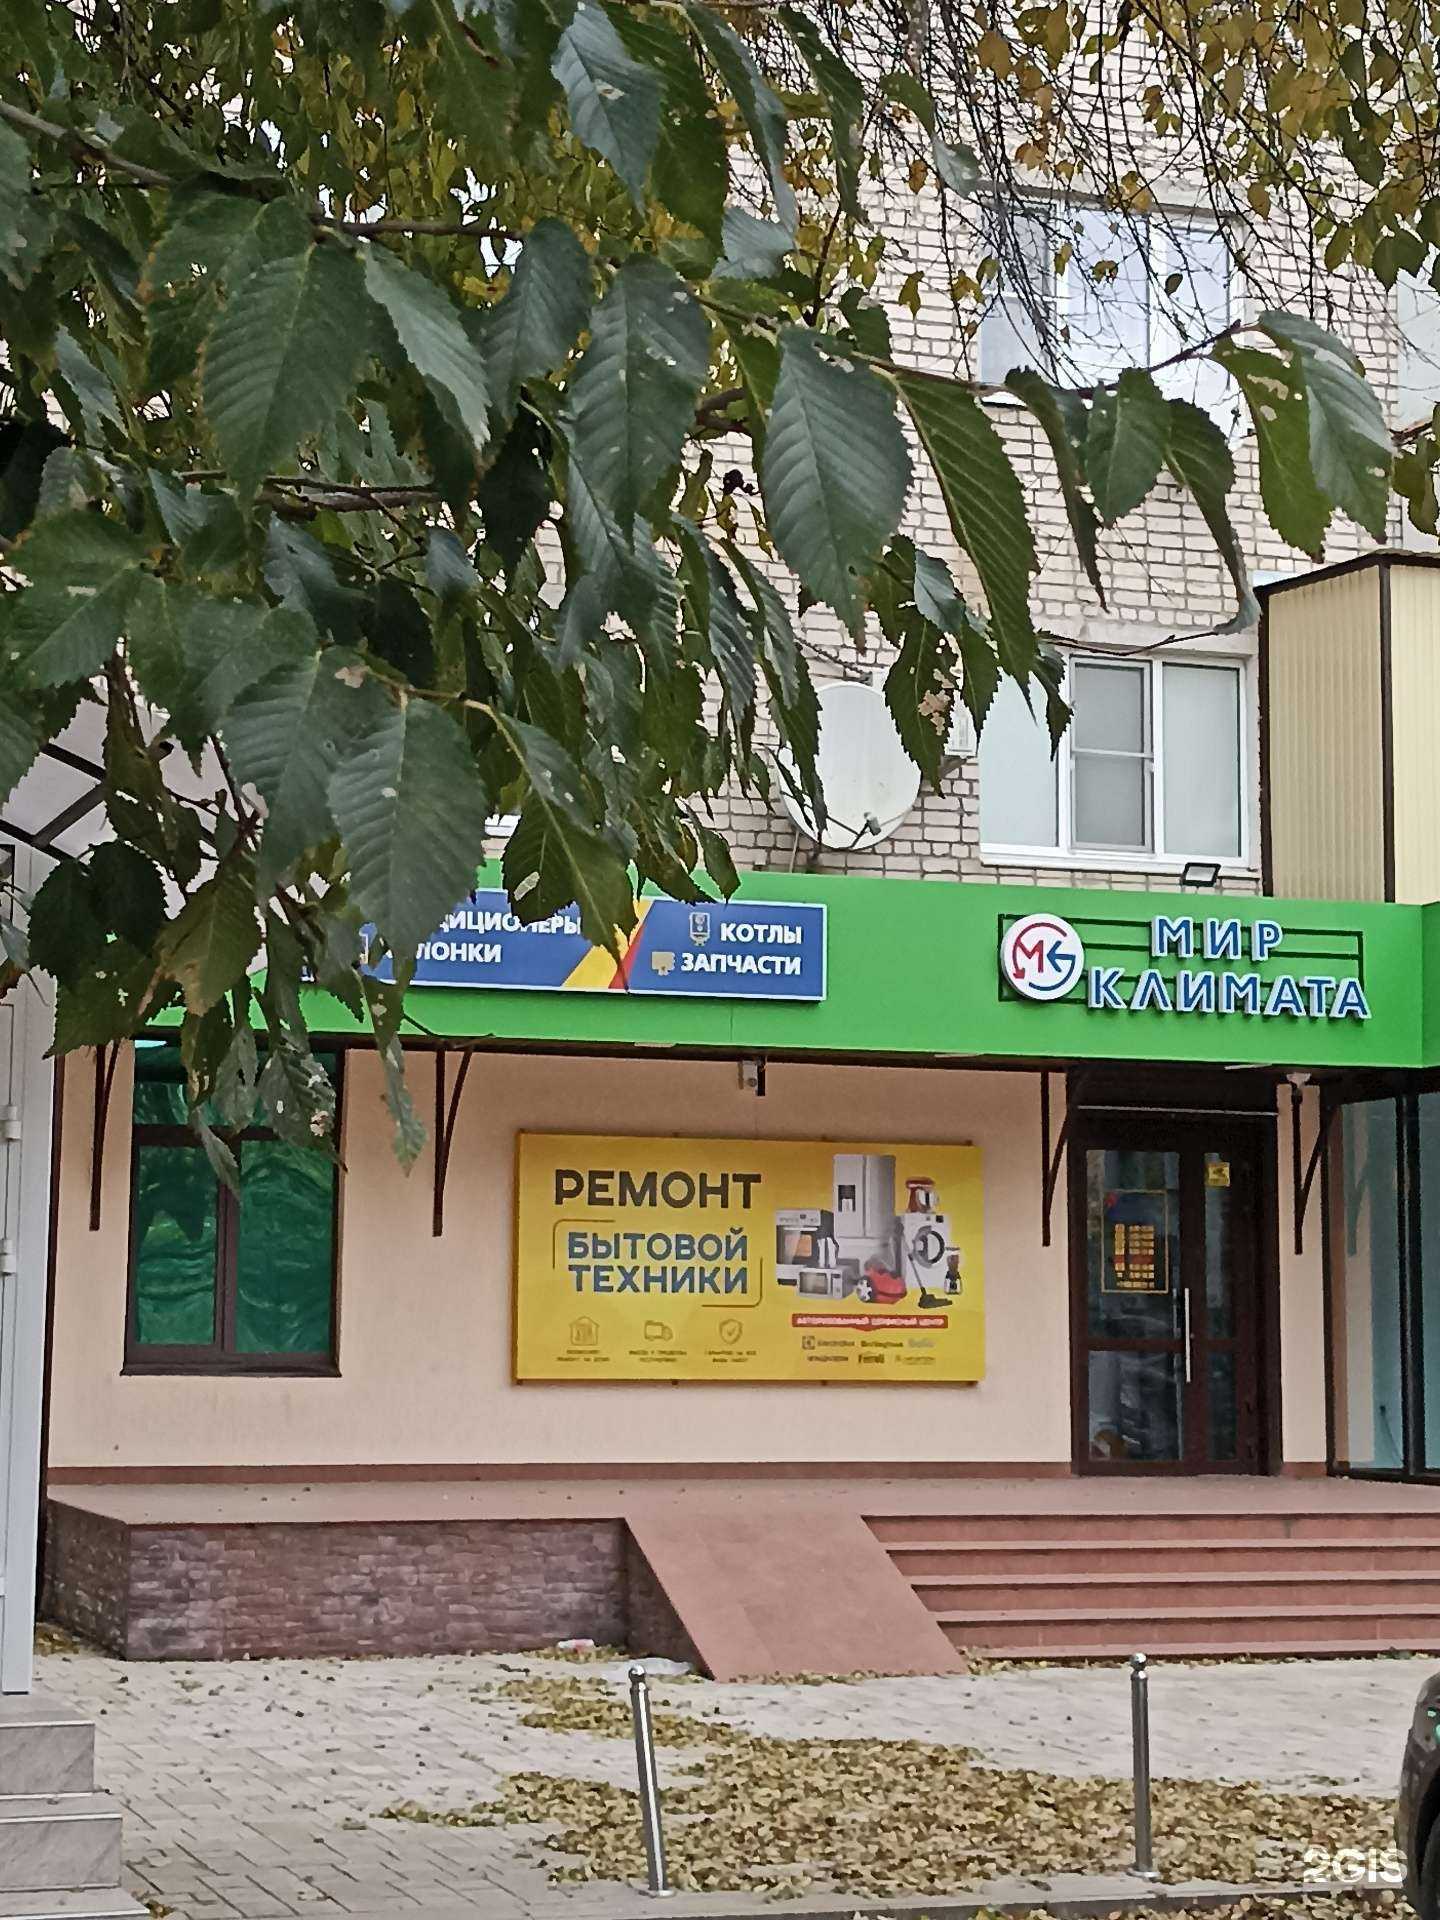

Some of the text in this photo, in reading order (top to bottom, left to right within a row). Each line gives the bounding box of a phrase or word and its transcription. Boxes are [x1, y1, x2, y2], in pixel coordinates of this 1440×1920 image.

[720, 922, 802, 944] КОТЛЫ
[1151, 915, 1283, 961] МИР
[416, 941, 502, 963] ЛОНКИ
[681, 952, 801, 975] ЗАПЧАСТИ
[1088, 967, 1372, 1019] КЛИМАТА
[554, 1169, 762, 1209] РЕМОНТ
[568, 1226, 748, 1262] БЫТОВОЙ
[568, 1264, 748, 1294] ТЕХНИКИ
